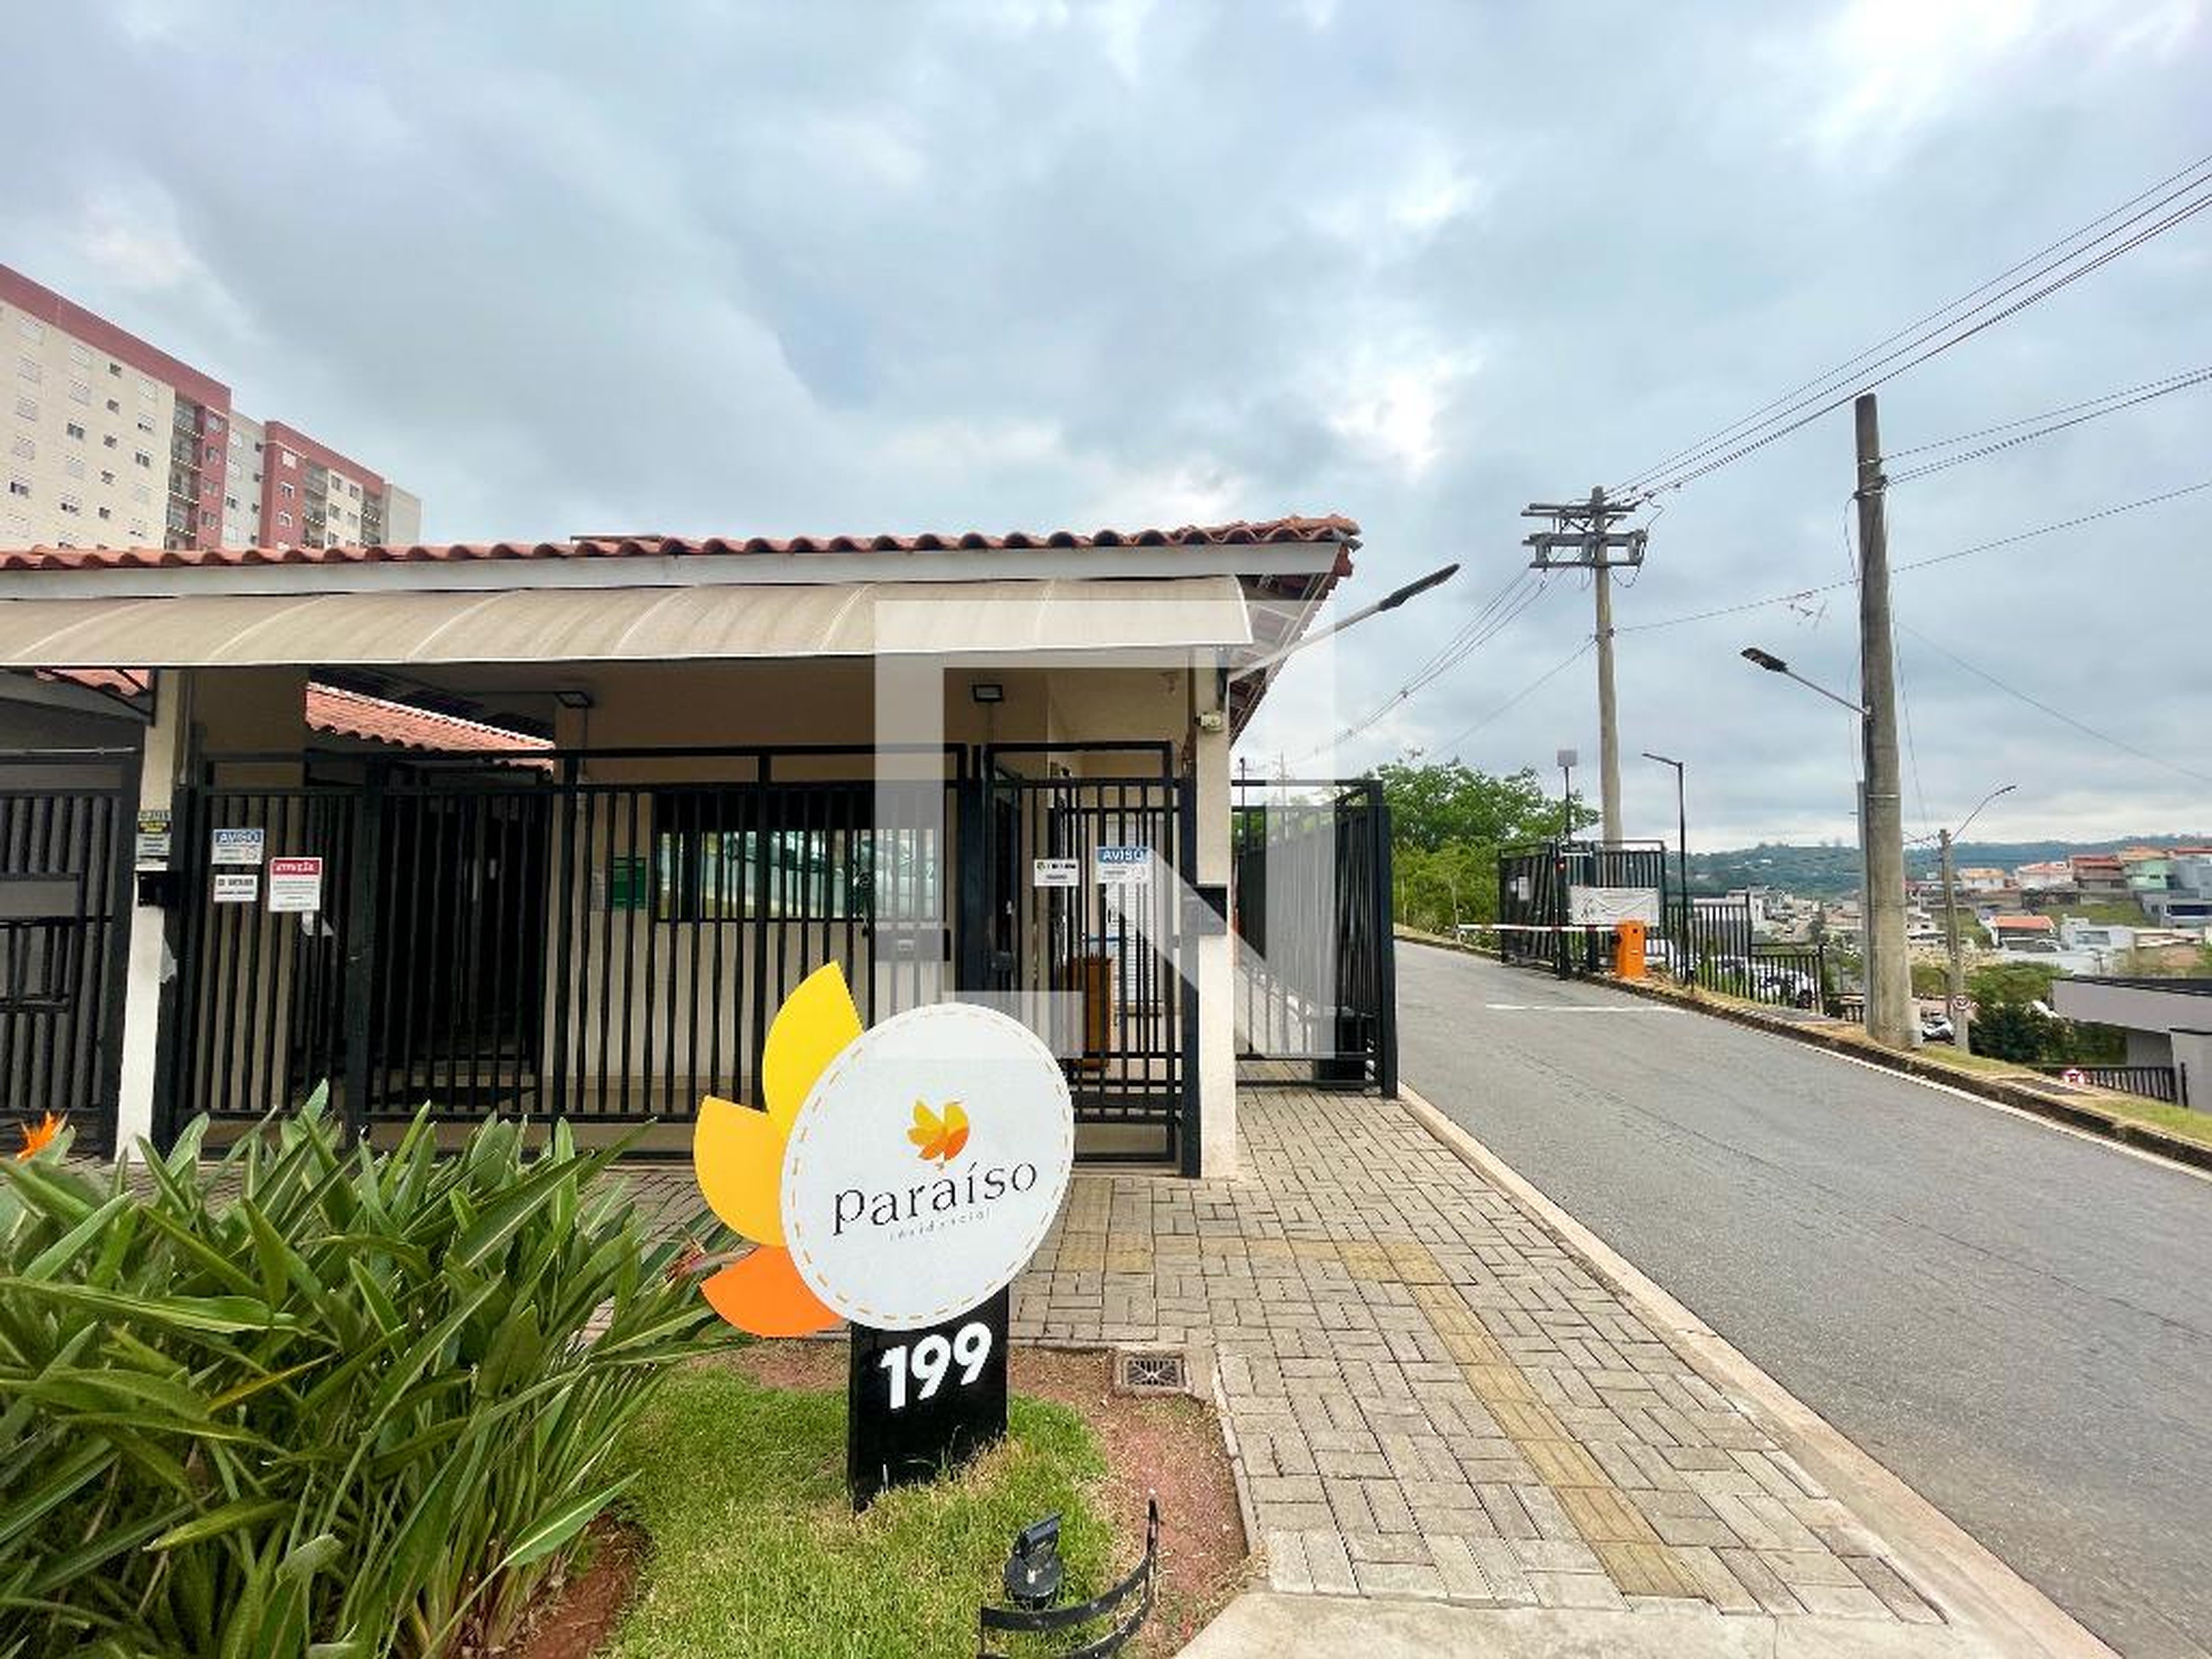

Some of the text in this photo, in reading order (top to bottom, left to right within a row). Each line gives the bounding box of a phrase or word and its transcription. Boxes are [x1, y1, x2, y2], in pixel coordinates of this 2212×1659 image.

[1103, 850, 1144, 862] AVISO
[833, 1161, 1037, 1236] paraíso
[879, 1322, 993, 1410] 199
